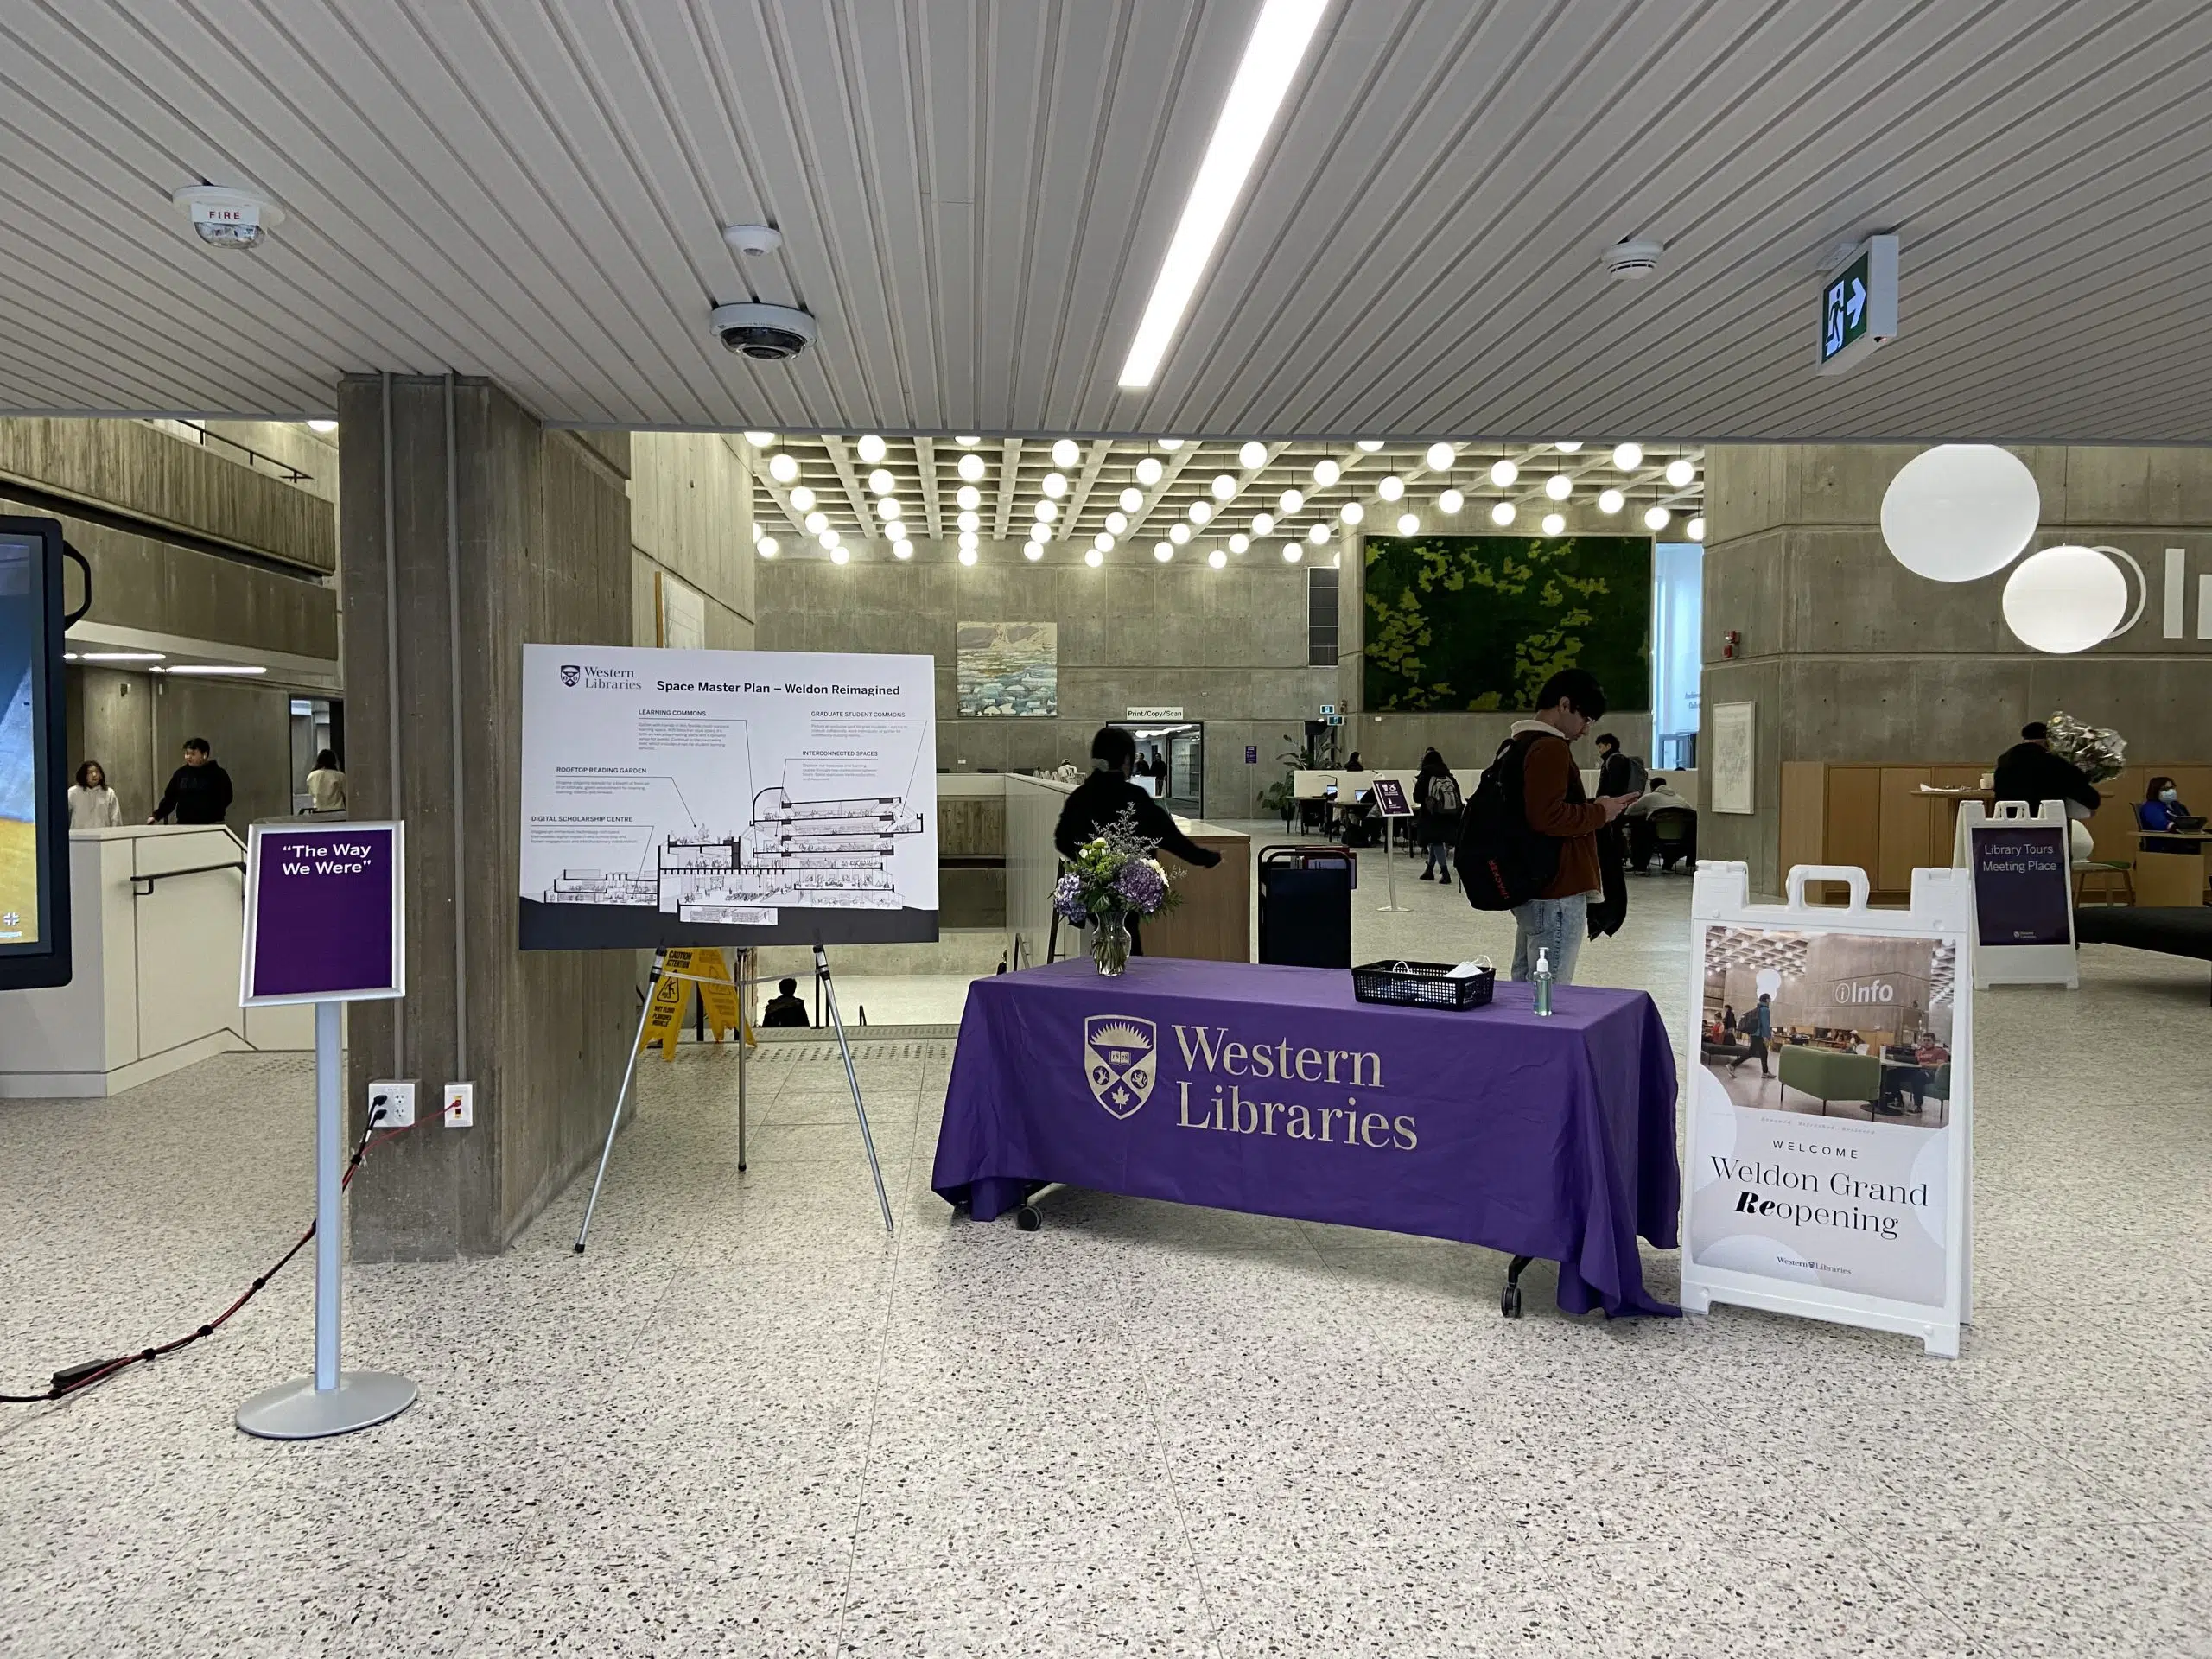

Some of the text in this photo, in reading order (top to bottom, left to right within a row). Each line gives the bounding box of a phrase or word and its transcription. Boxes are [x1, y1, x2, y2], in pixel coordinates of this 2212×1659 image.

[209, 211, 240, 219] FIRE
[584, 666, 635, 678] Western
[585, 678, 642, 690] Libraries
[657, 680, 695, 693] Space
[698, 682, 741, 692] Master
[744, 683, 770, 693] Plan
[785, 683, 828, 695] Weldon
[831, 684, 900, 697] Reimagined
[333, 843, 372, 858] Way
[1984, 843, 2054, 856] Library Tours
[282, 863, 311, 875] We
[1983, 861, 2056, 874] Meeting Place
[668, 950, 693, 960] CAUTION
[1851, 979, 1893, 1003] Info
[1171, 1024, 1385, 1088] Western
[1176, 1081, 1418, 1151] Libraries
[1772, 1140, 1859, 1159] WELCOME
[1710, 1155, 1929, 1207] Weldon Grand
[1734, 1191, 1899, 1241] Reopening
[1777, 1256, 1852, 1274] Western Libraries
